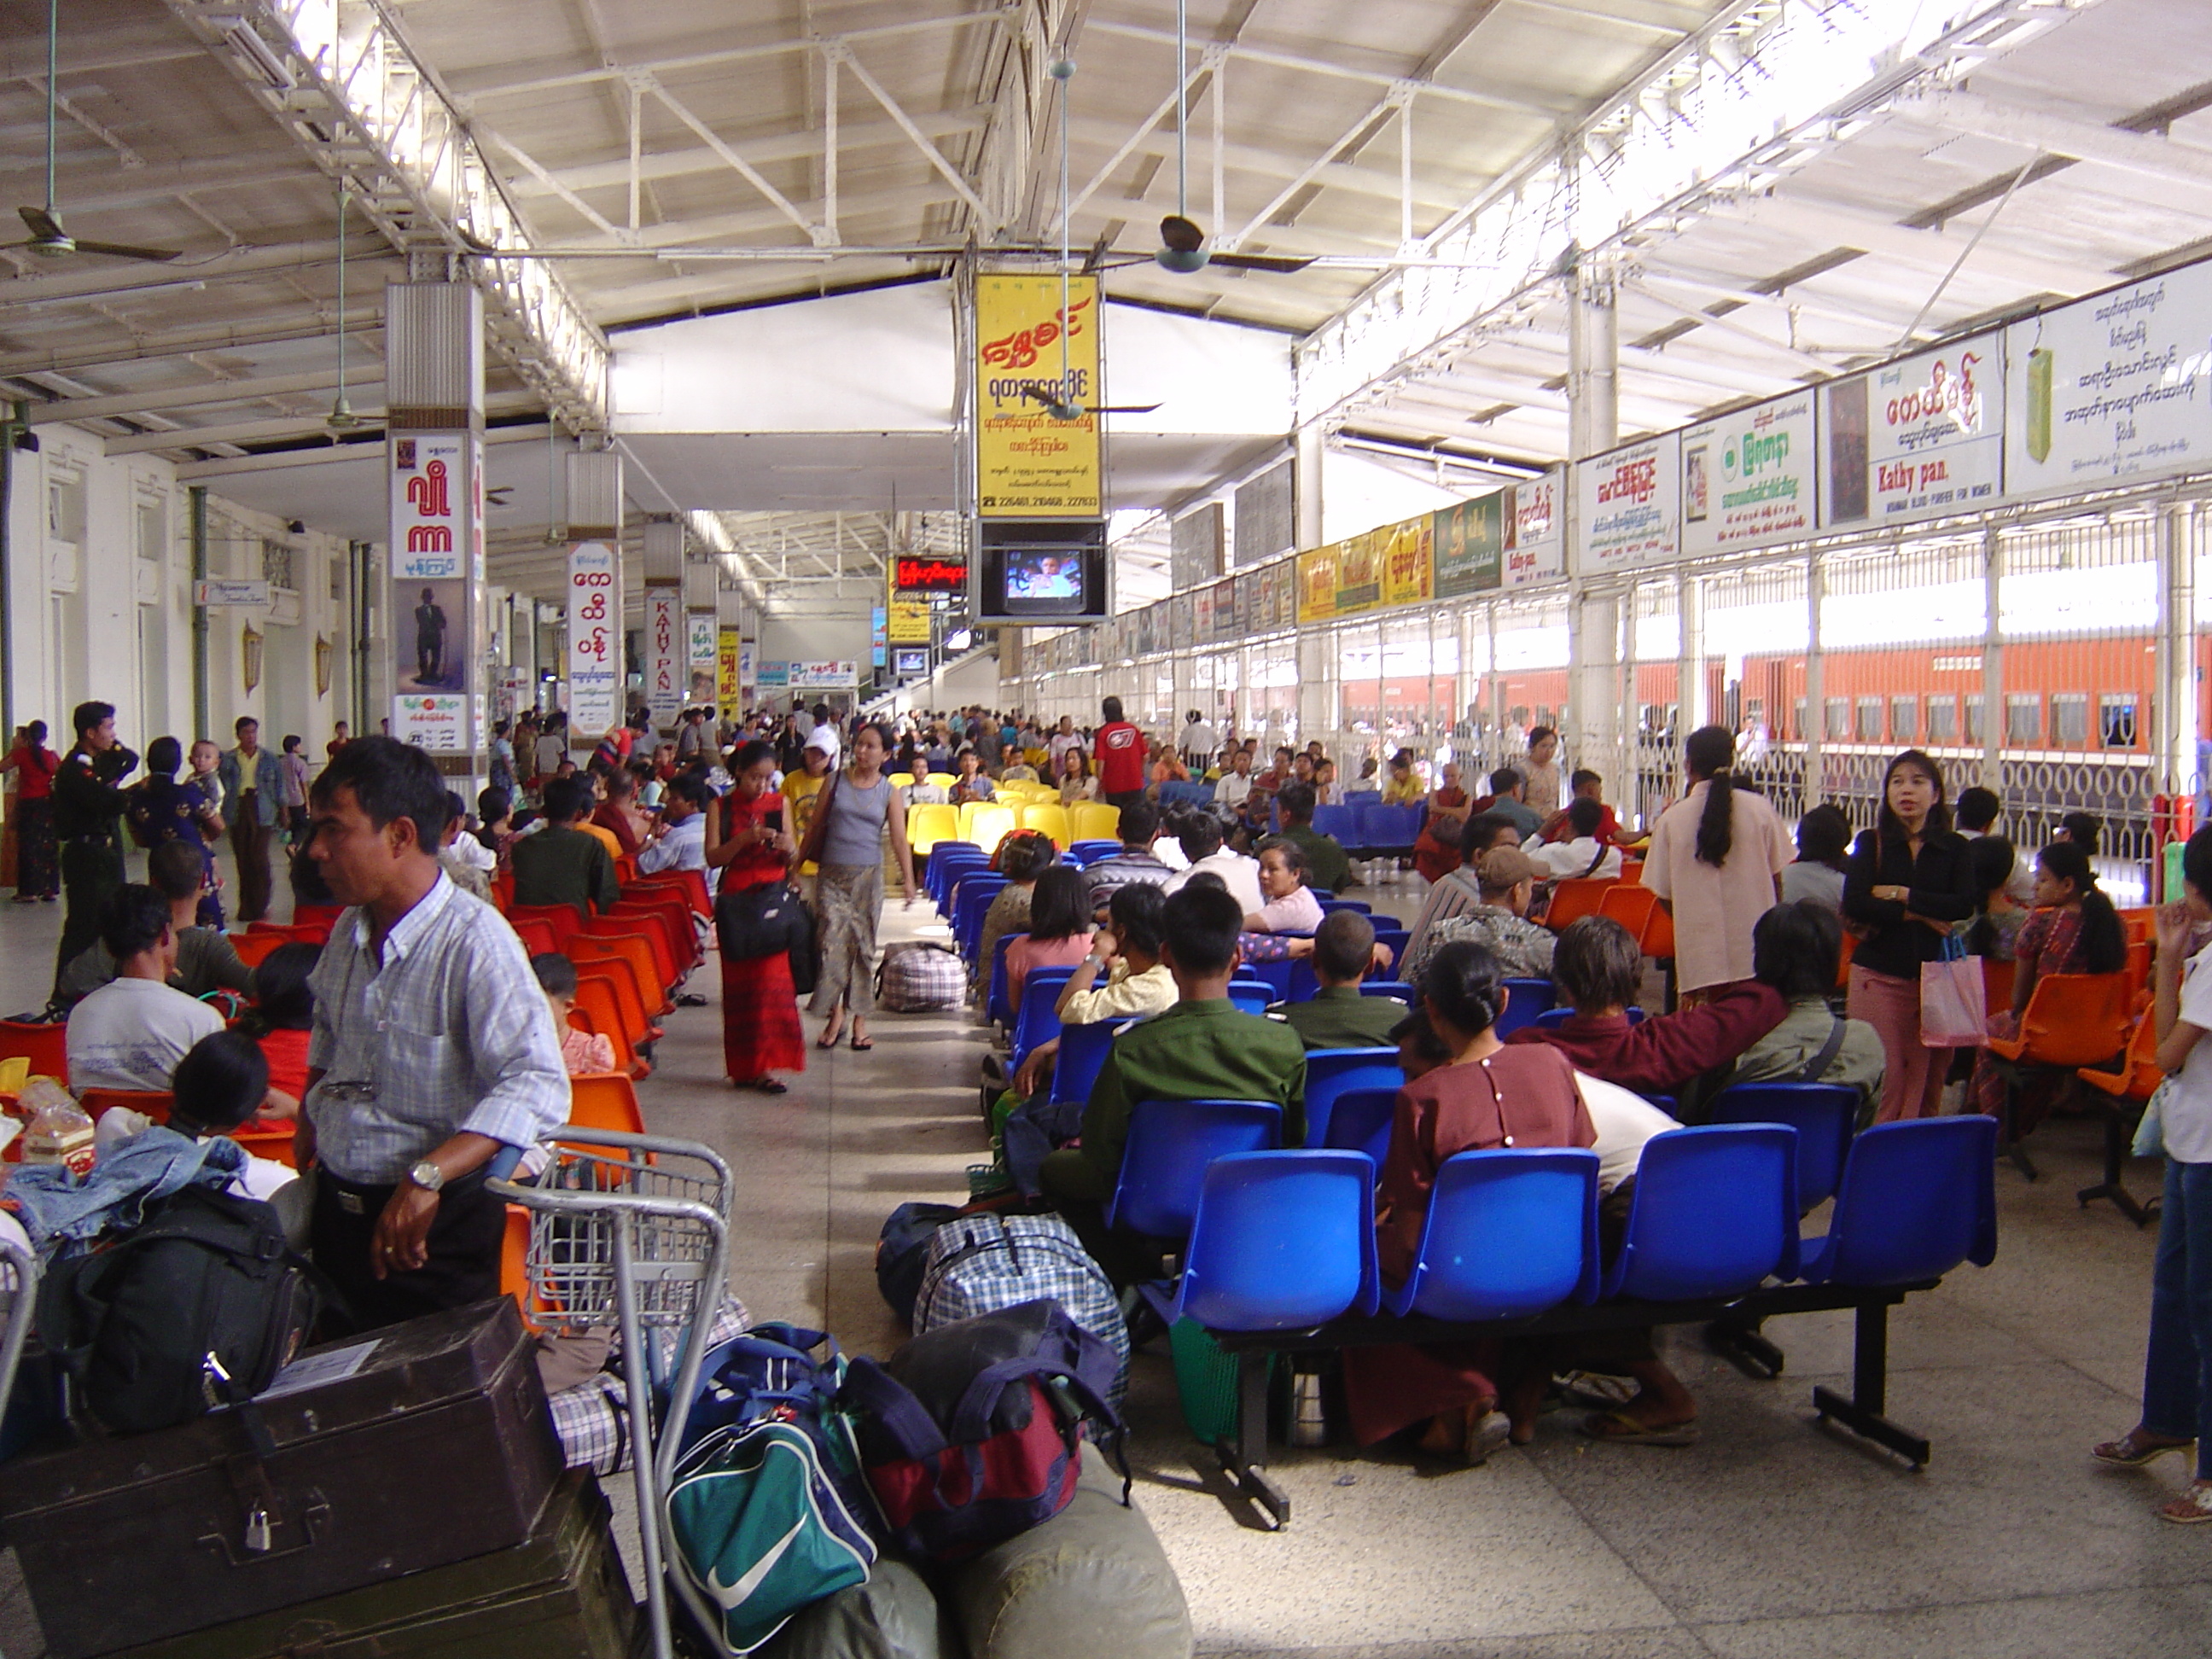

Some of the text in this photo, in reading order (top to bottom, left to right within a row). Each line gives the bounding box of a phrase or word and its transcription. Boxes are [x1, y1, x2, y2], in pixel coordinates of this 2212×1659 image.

[1877, 461, 1914, 494] Kathy
[656, 602, 671, 690] KATHY PAN
